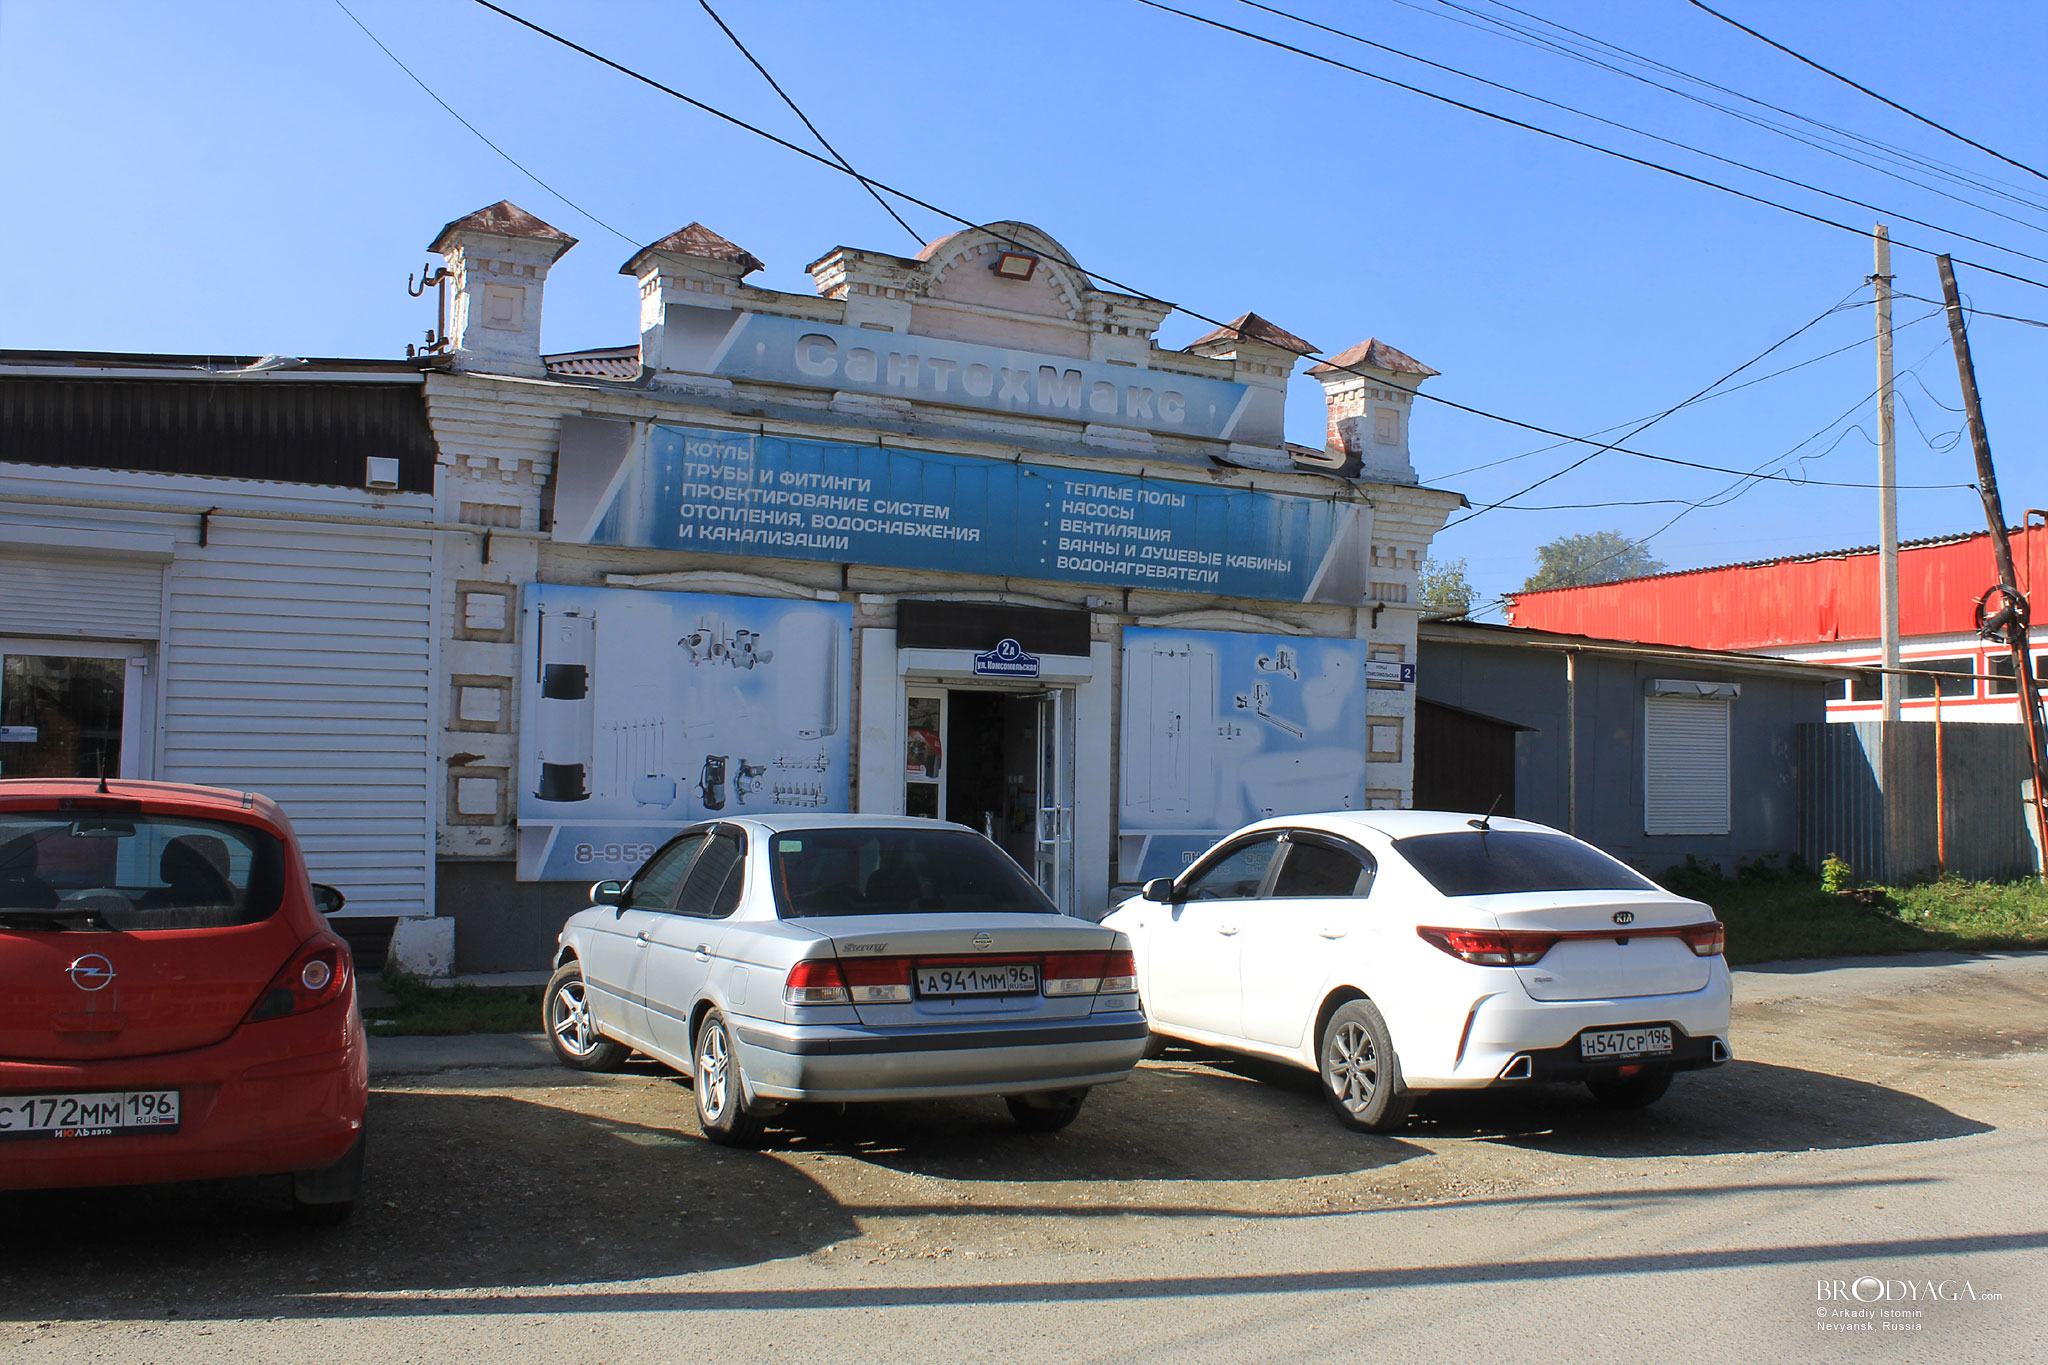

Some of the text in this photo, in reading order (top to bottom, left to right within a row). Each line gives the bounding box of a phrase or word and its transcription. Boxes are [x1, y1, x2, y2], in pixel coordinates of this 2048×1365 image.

[795, 332, 1187, 424] СантохМакс
[685, 441, 754, 461] КОТЛЫ
[684, 462, 871, 493] ТРУБЫ И ФИТИНГИ
[682, 483, 950, 520] ПРОЕКТИРОВАНИЕ СИСТЕМ
[1064, 481, 1186, 508] ТЕПЛЫЕ ПОЛЫ
[1062, 500, 1135, 520] НАСОСЫ
[680, 504, 981, 542] ОТОПЛЕНИЯ, ВОДОСНАБЖЕНИЯ
[1060, 519, 1172, 542] ВЕНТИЛЯЦИЯ
[678, 524, 849, 550] И КАНАЛИЗАЦИИ
[1058, 537, 1291, 573] ВАННЫ И ДУШЕВЫЕ КАБИНЫ
[1057, 556, 1219, 583] ВОДОНАГРЕВАТЕЛИ
[1404, 668, 1411, 679] 2
[1616, 913, 1633, 923] KIA
[843, 943, 888, 953] Sunny
[1008, 967, 1028, 983] 96
[1647, 1029, 1668, 1044] 196
[127, 1093, 171, 1117] 196
[136, 1115, 158, 1124] RUS
[54, 1129, 90, 1138] ИЮЛЬ
